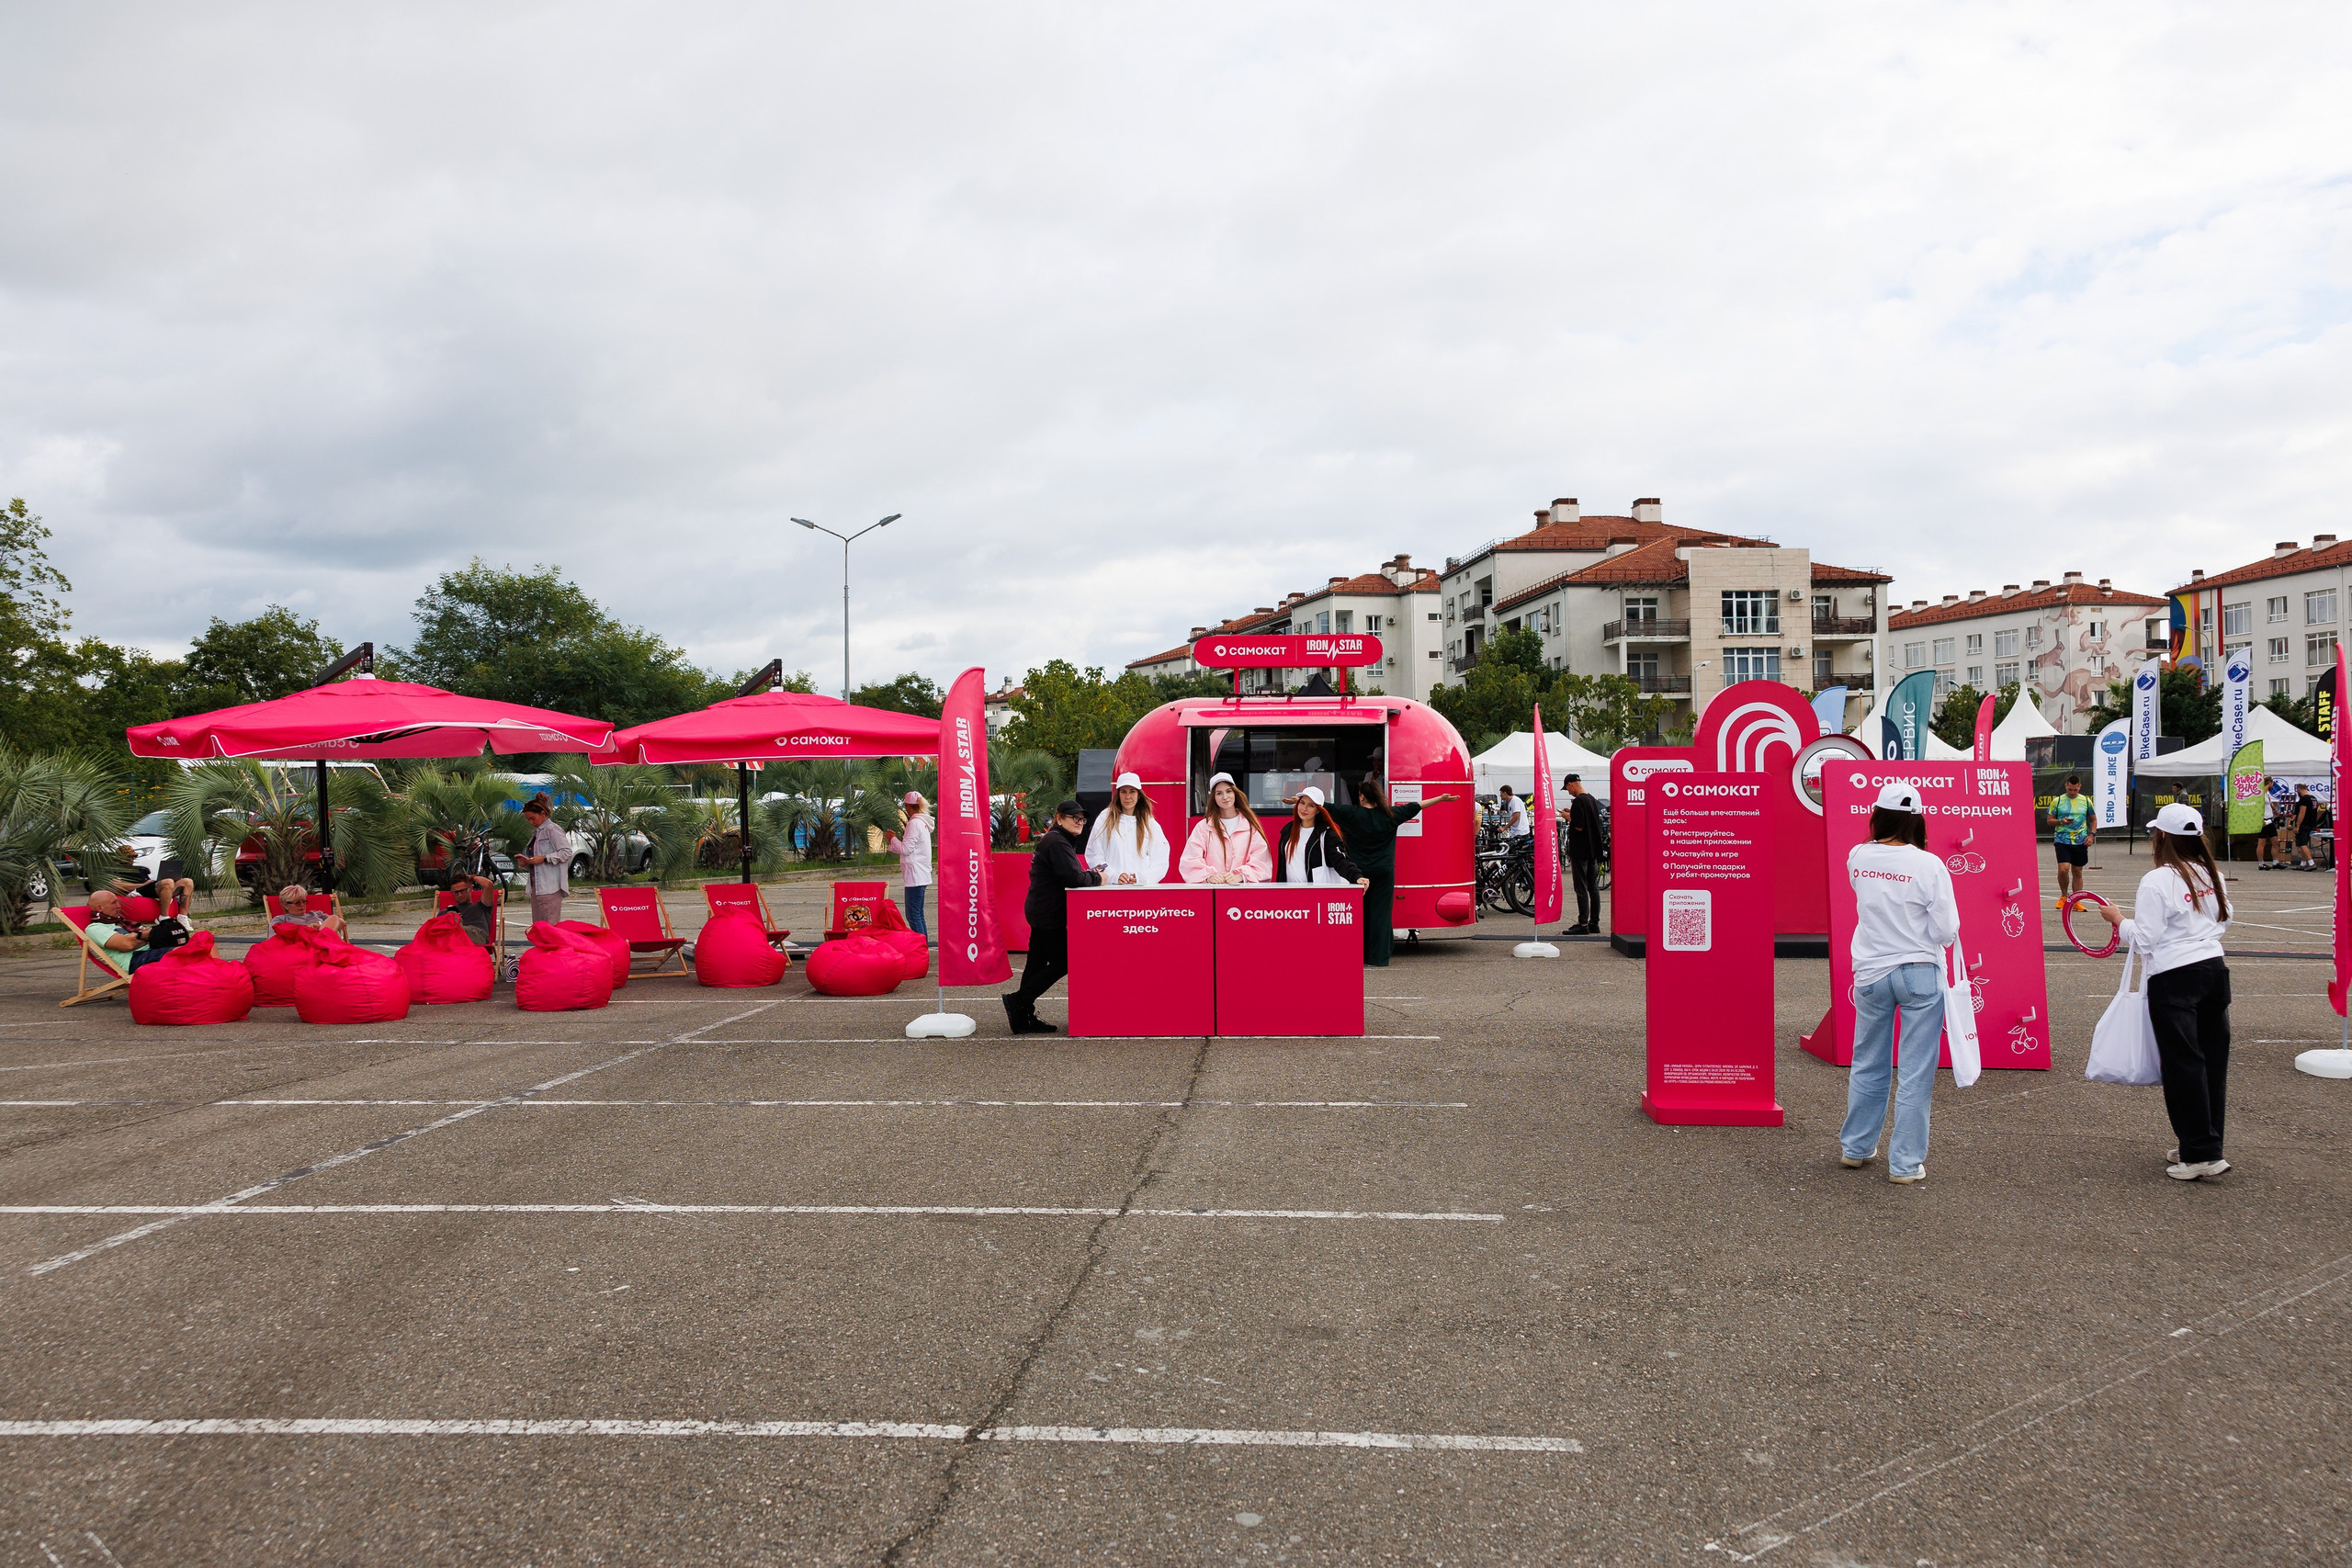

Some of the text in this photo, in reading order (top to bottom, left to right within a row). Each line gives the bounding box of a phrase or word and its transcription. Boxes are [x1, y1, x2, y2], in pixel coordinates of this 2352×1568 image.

[1229, 646, 1286, 656] самокат
[1306, 639, 1363, 651] IRON STAR
[2318, 691, 2331, 732] STAFF
[1903, 701, 1916, 761] ЕРВИС
[2140, 696, 2150, 760] BikeCase.ru
[790, 736, 852, 745] самокат
[956, 716, 974, 818] IRON STAR
[1976, 769, 1999, 780] IRON
[2233, 771, 2264, 786] Sweet
[1682, 784, 1760, 796] самокат
[1978, 781, 2010, 795] STAR
[1627, 789, 1645, 801] IRO
[2154, 794, 2202, 805] IRON TAR
[1663, 808, 1760, 817] Ещё больше впечатлений
[1941, 805, 2012, 818] сердцем
[1670, 829, 1736, 838] Регистрируйтесь
[1670, 863, 1712, 871] Получайте
[1676, 871, 1751, 879] ребят-промоутеров
[1861, 870, 1913, 883] самокат
[967, 849, 978, 939] самокат
[1328, 902, 1345, 912] IRON
[1087, 907, 1195, 920] регистрируйтесь
[1244, 909, 1310, 920] самокат
[1328, 912, 1353, 925] STAR
[1123, 924, 1159, 934] здесь
